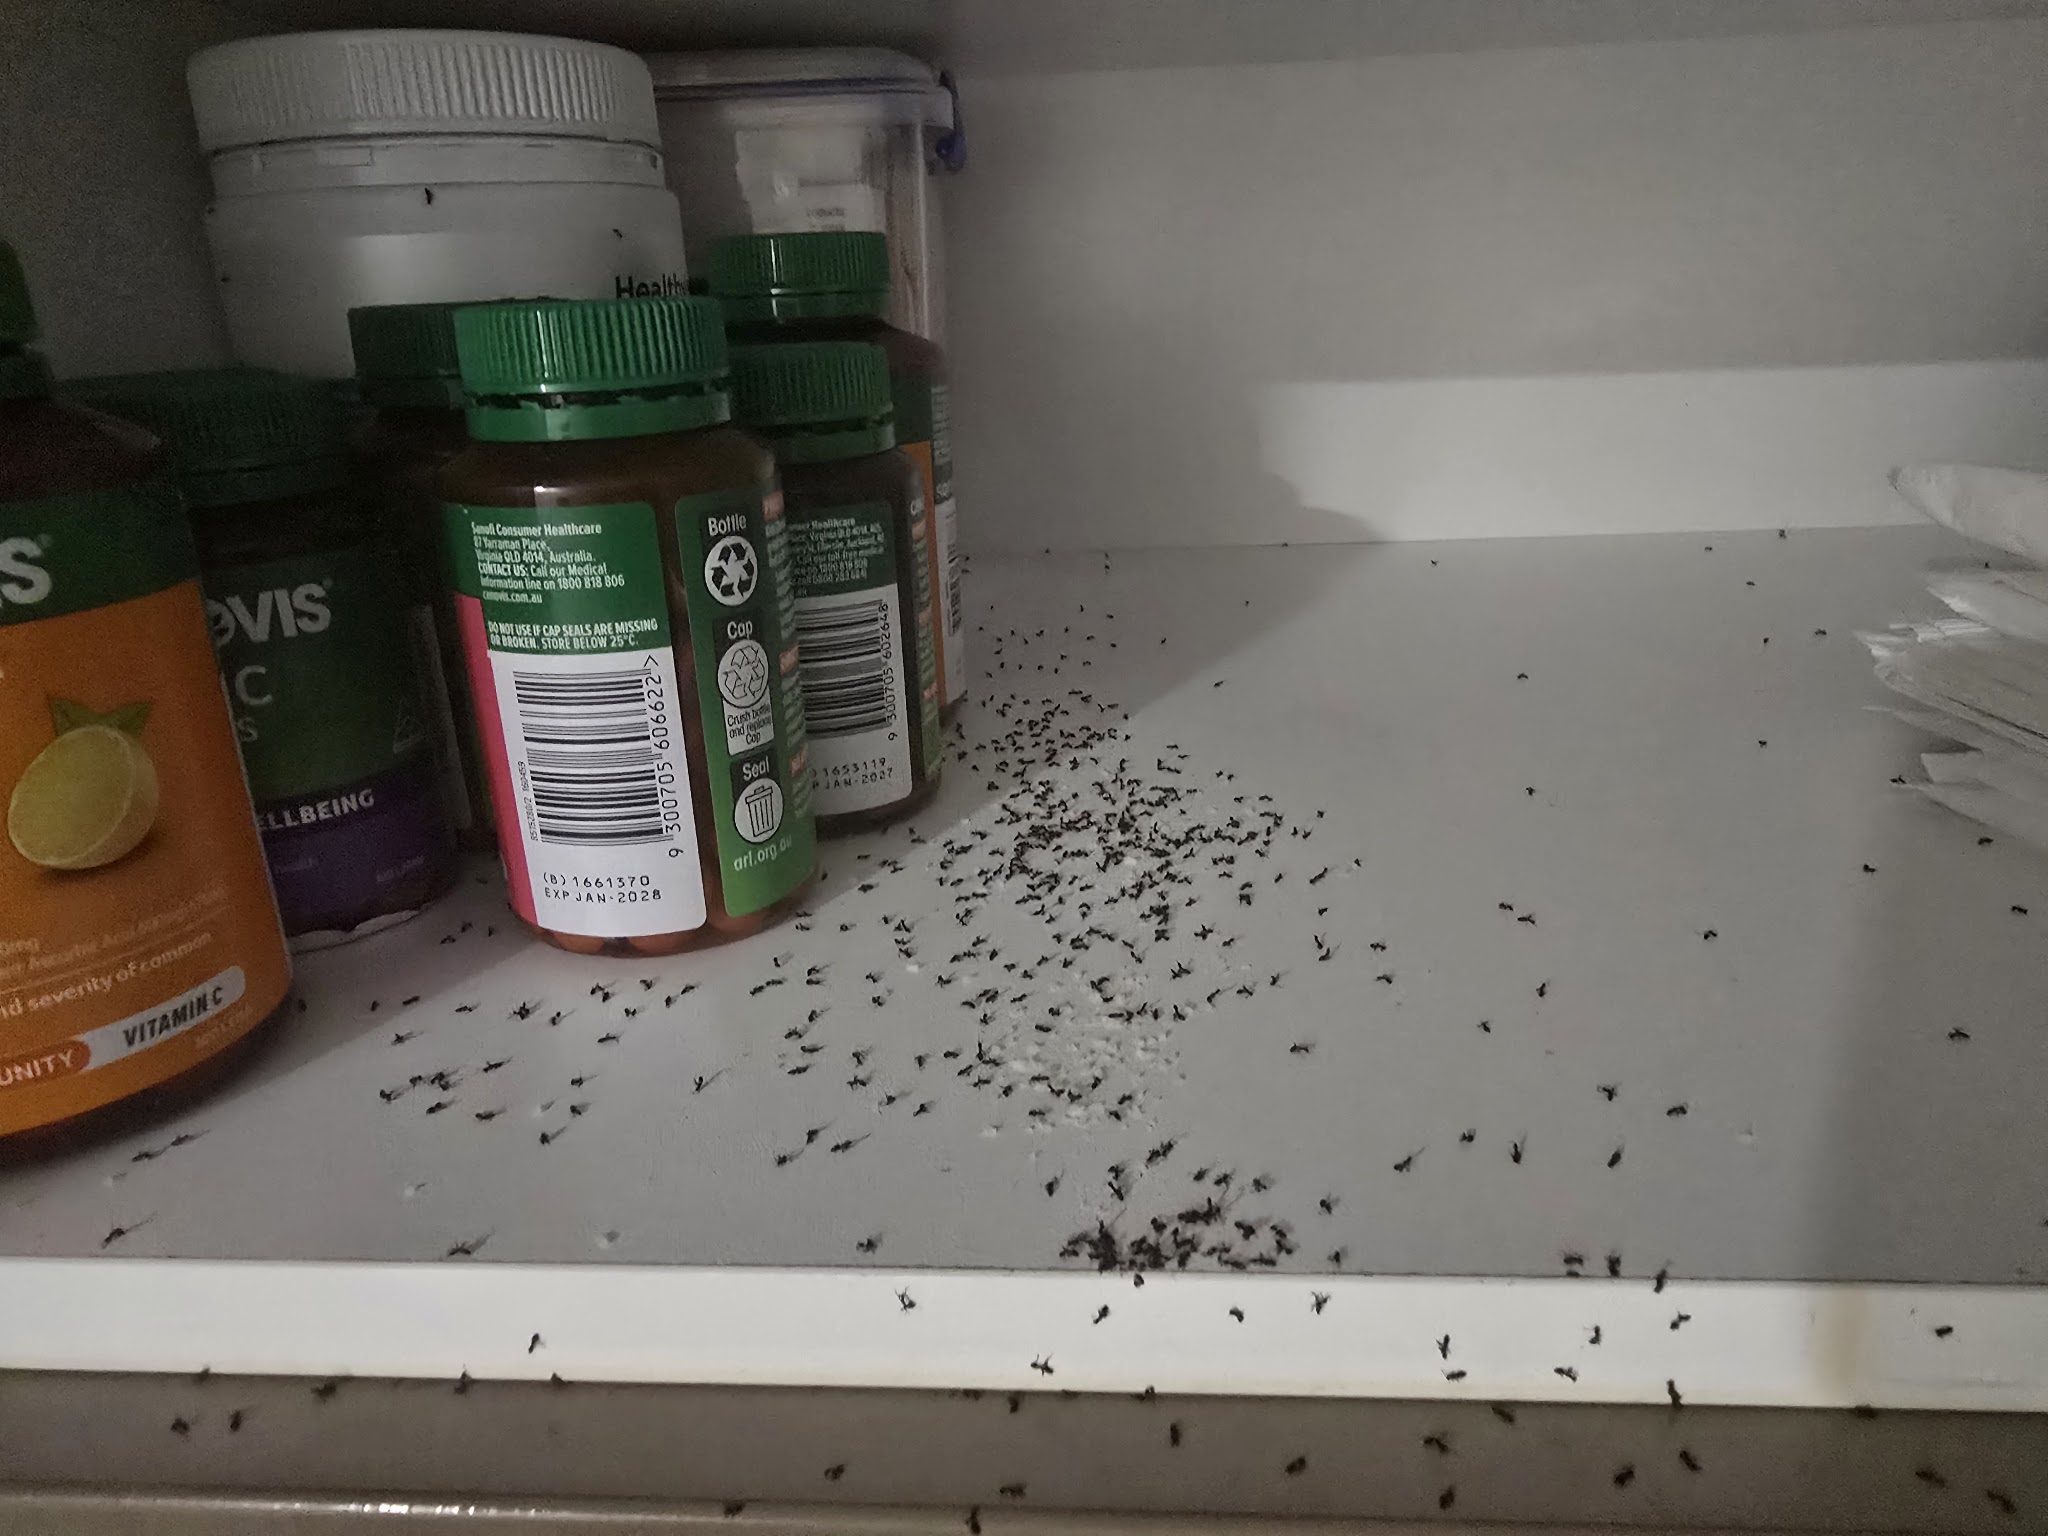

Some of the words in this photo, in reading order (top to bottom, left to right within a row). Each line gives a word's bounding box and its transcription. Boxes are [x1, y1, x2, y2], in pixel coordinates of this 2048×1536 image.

[496, 523, 541, 536] Consumer
[544, 523, 602, 536] Healthcare
[707, 513, 747, 536] Bottle
[483, 536, 520, 550] Yarraman
[522, 538, 551, 552] Place,
[504, 551, 521, 563] QLD
[522, 551, 547, 565] 4014,
[549, 550, 596, 564] Australia.
[478, 562, 511, 576] CONTACT
[512, 564, 528, 577] US:
[530, 565, 548, 578] Call
[550, 566, 565, 578] our
[568, 562, 608, 577] Medical
[525, 578, 541, 590] line
[543, 580, 556, 591] on
[558, 578, 582, 590] 1800
[584, 576, 603, 588] 818
[604, 574, 625, 588] 806
[488, 620, 498, 633] DO
[500, 622, 514, 636] NOT
[516, 622, 532, 637] USE
[533, 624, 541, 636] IF
[542, 624, 560, 637] CAP
[562, 624, 592, 637] SEALS
[594, 622, 614, 636] ARE
[615, 618, 658, 634] MISSING
[727, 620, 753, 640] Cap
[490, 634, 500, 646] OR
[502, 635, 540, 650] BROKEN.
[541, 636, 570, 650] STORE
[573, 636, 608, 650] BELOW
[883, 667, 898, 723] 300705
[645, 674, 670, 750] 606622
[727, 711, 751, 728] Crush
[729, 723, 744, 739] and
[888, 732, 898, 741] 9
[742, 755, 770, 782] Seal
[656, 762, 682, 833] 300705
[668, 848, 684, 858] 9
[733, 834, 793, 872] arl.org.au
[544, 888, 570, 900] EXP
[575, 889, 662, 904] JAN-2028
[29, 973, 113, 1012] severity
[116, 960, 137, 984] of
[140, 932, 213, 973] common
[123, 992, 209, 1048] VITAMIN
[208, 986, 224, 1006] C
